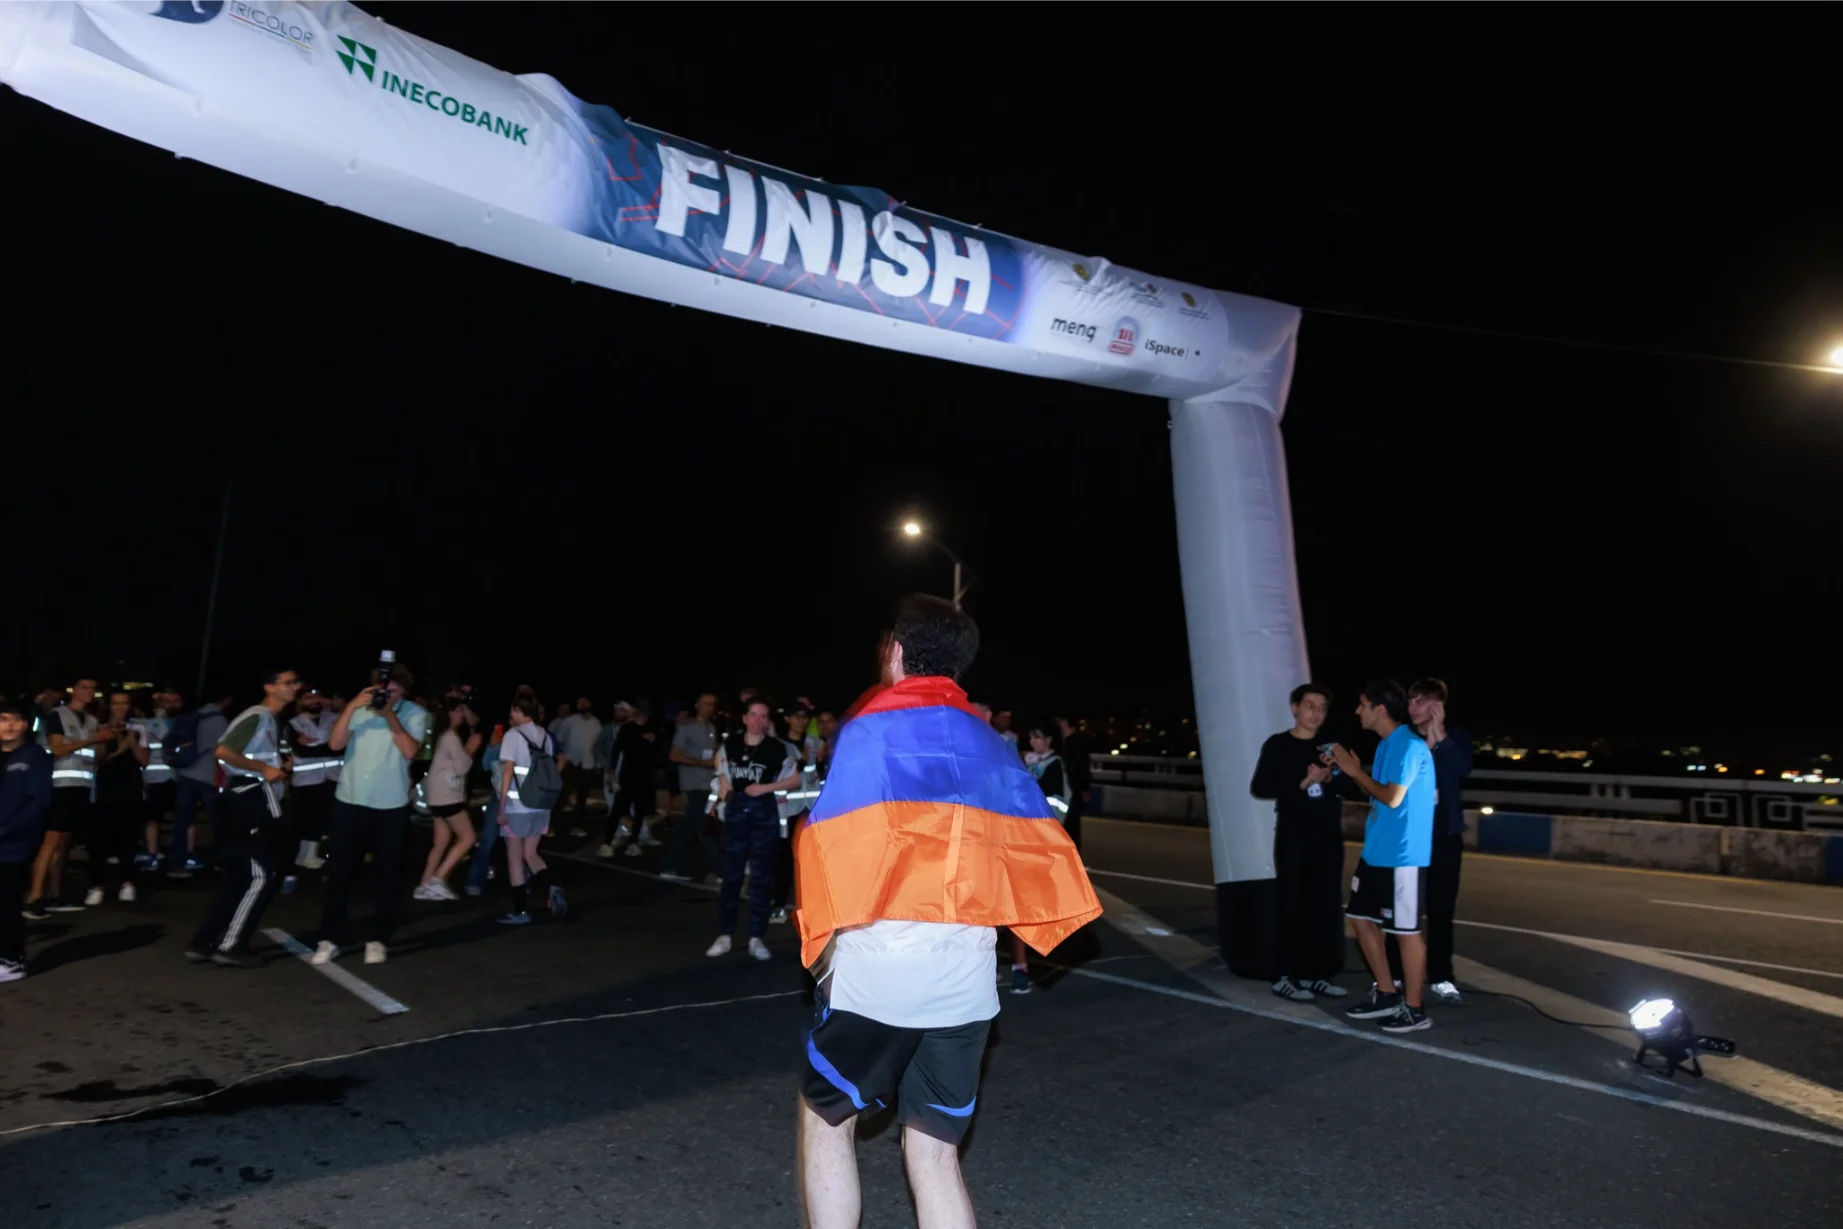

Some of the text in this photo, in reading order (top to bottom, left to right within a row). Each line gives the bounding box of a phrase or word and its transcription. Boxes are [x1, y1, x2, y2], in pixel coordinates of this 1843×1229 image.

[230, 0, 314, 45] TRICOLOR
[381, 70, 529, 146] INECOBANK
[655, 142, 991, 315] FINISH
[1050, 318, 1097, 343] menq
[1144, 339, 1185, 357] iSpace
